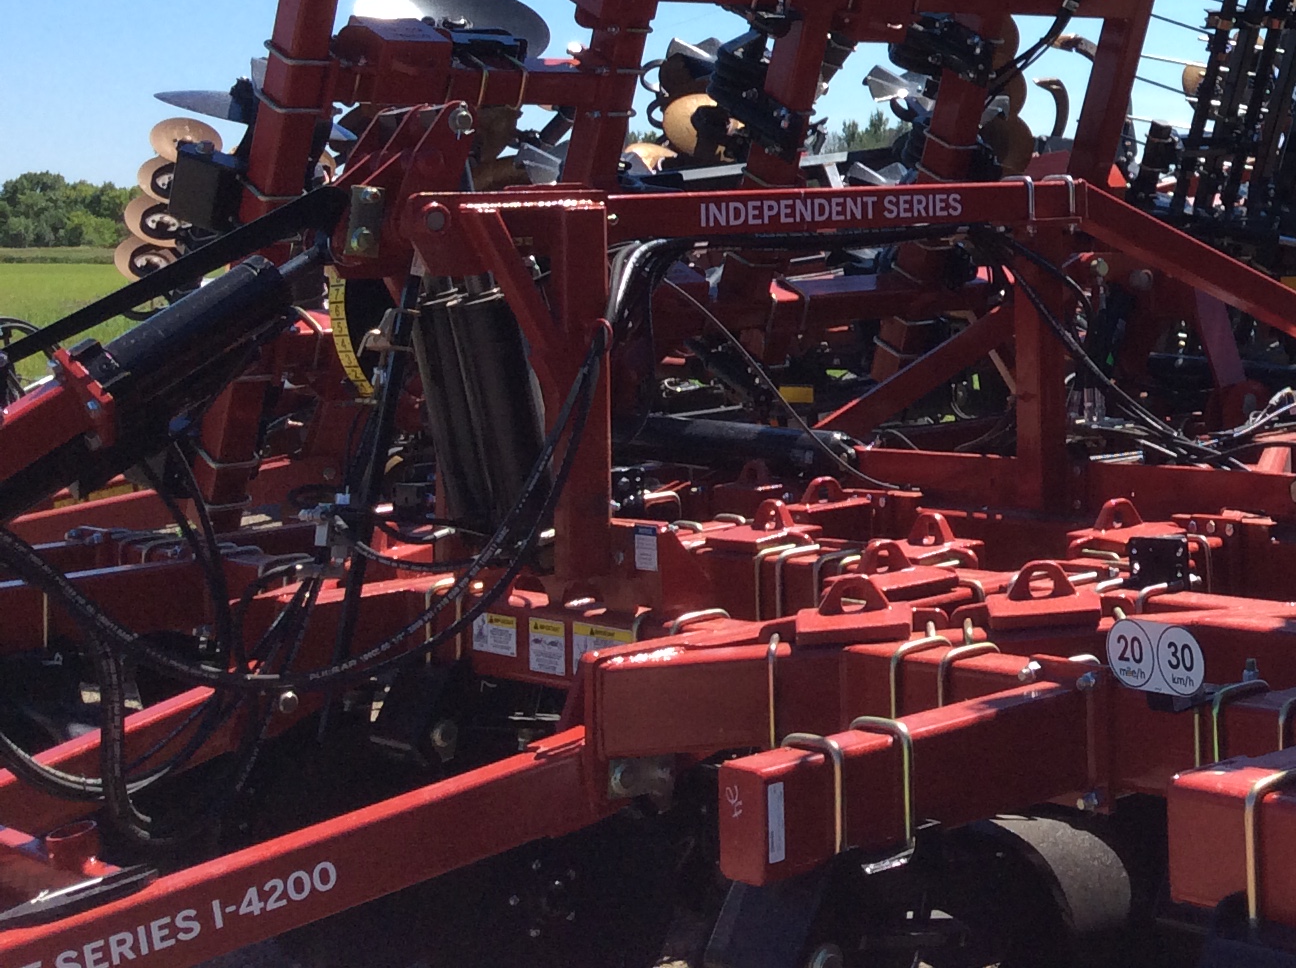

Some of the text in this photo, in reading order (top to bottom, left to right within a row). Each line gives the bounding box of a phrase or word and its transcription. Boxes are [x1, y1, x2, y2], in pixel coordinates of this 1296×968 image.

[700, 193, 963, 227] INDEPENDENT SERIES
[1116, 634, 1144, 664] 20
[1167, 641, 1195, 673] 30
[1171, 673, 1195, 688] km/h
[55, 861, 338, 968] SERIES I-4200
